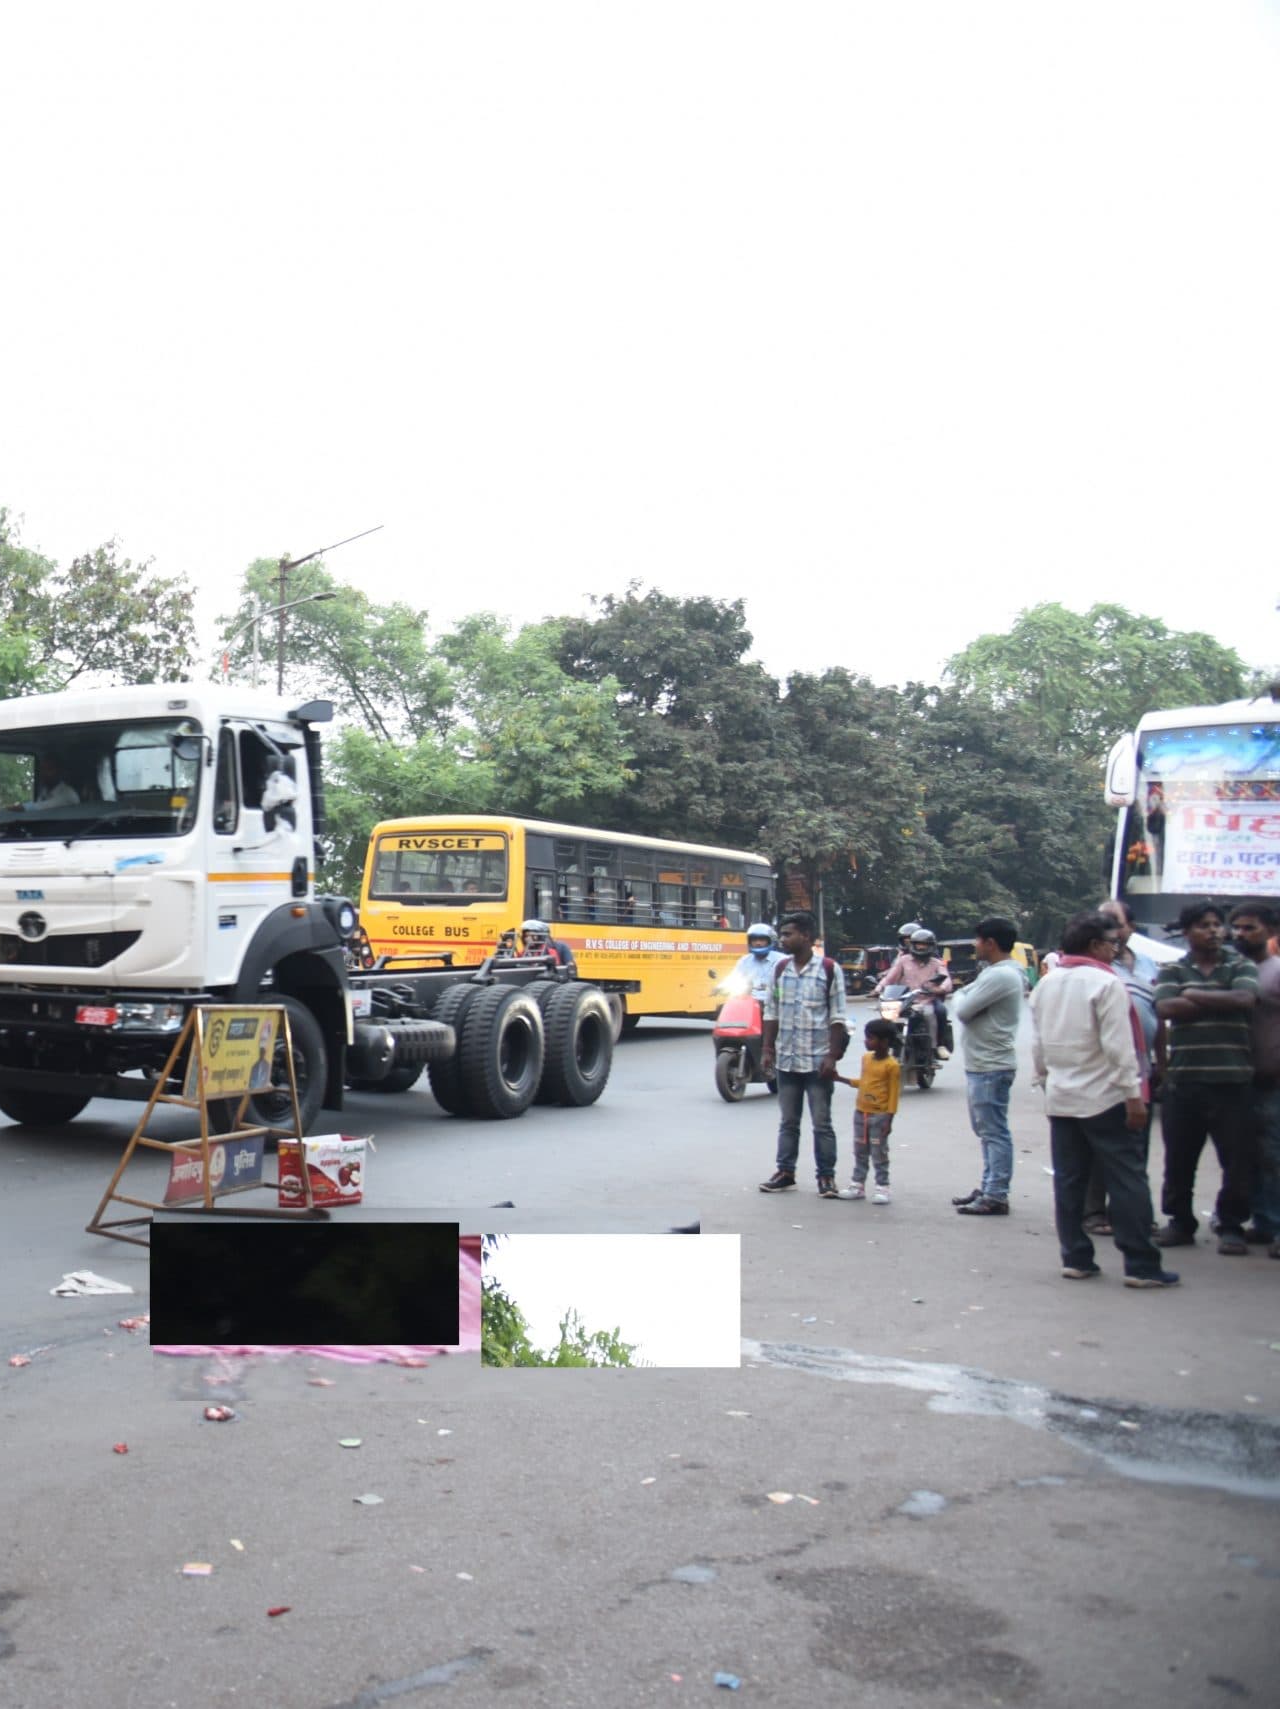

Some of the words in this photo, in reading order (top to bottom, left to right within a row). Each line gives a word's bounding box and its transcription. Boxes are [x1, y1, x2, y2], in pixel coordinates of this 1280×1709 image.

[398, 838, 485, 849] RVSCET
[16, 889, 44, 900] TATA
[392, 925, 435, 936] COLLEGE
[444, 926, 470, 938] BUS
